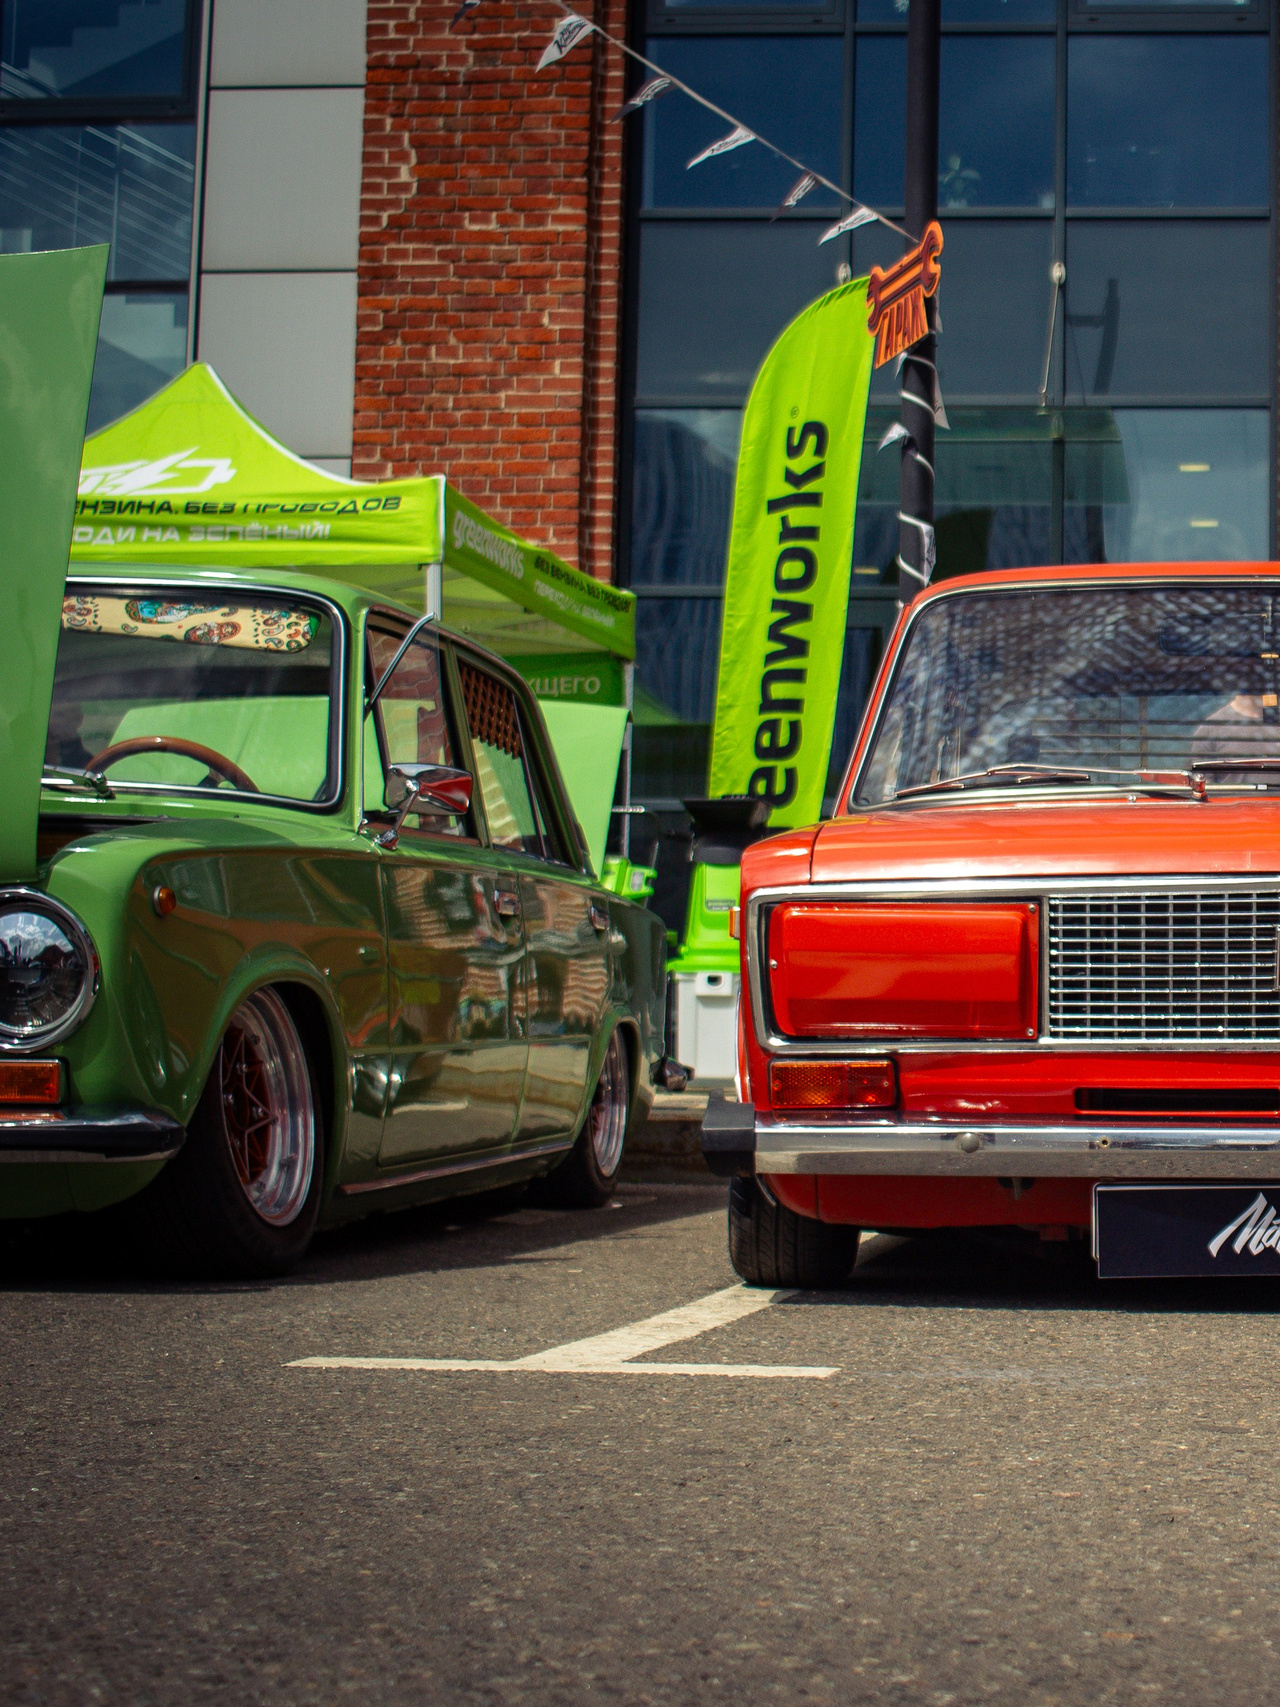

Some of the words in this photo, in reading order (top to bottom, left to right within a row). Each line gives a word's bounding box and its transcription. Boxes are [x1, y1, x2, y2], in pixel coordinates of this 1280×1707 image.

[184, 501, 236, 515] БЕЗ
[141, 526, 180, 542] НА
[453, 510, 524, 580] greenworks
